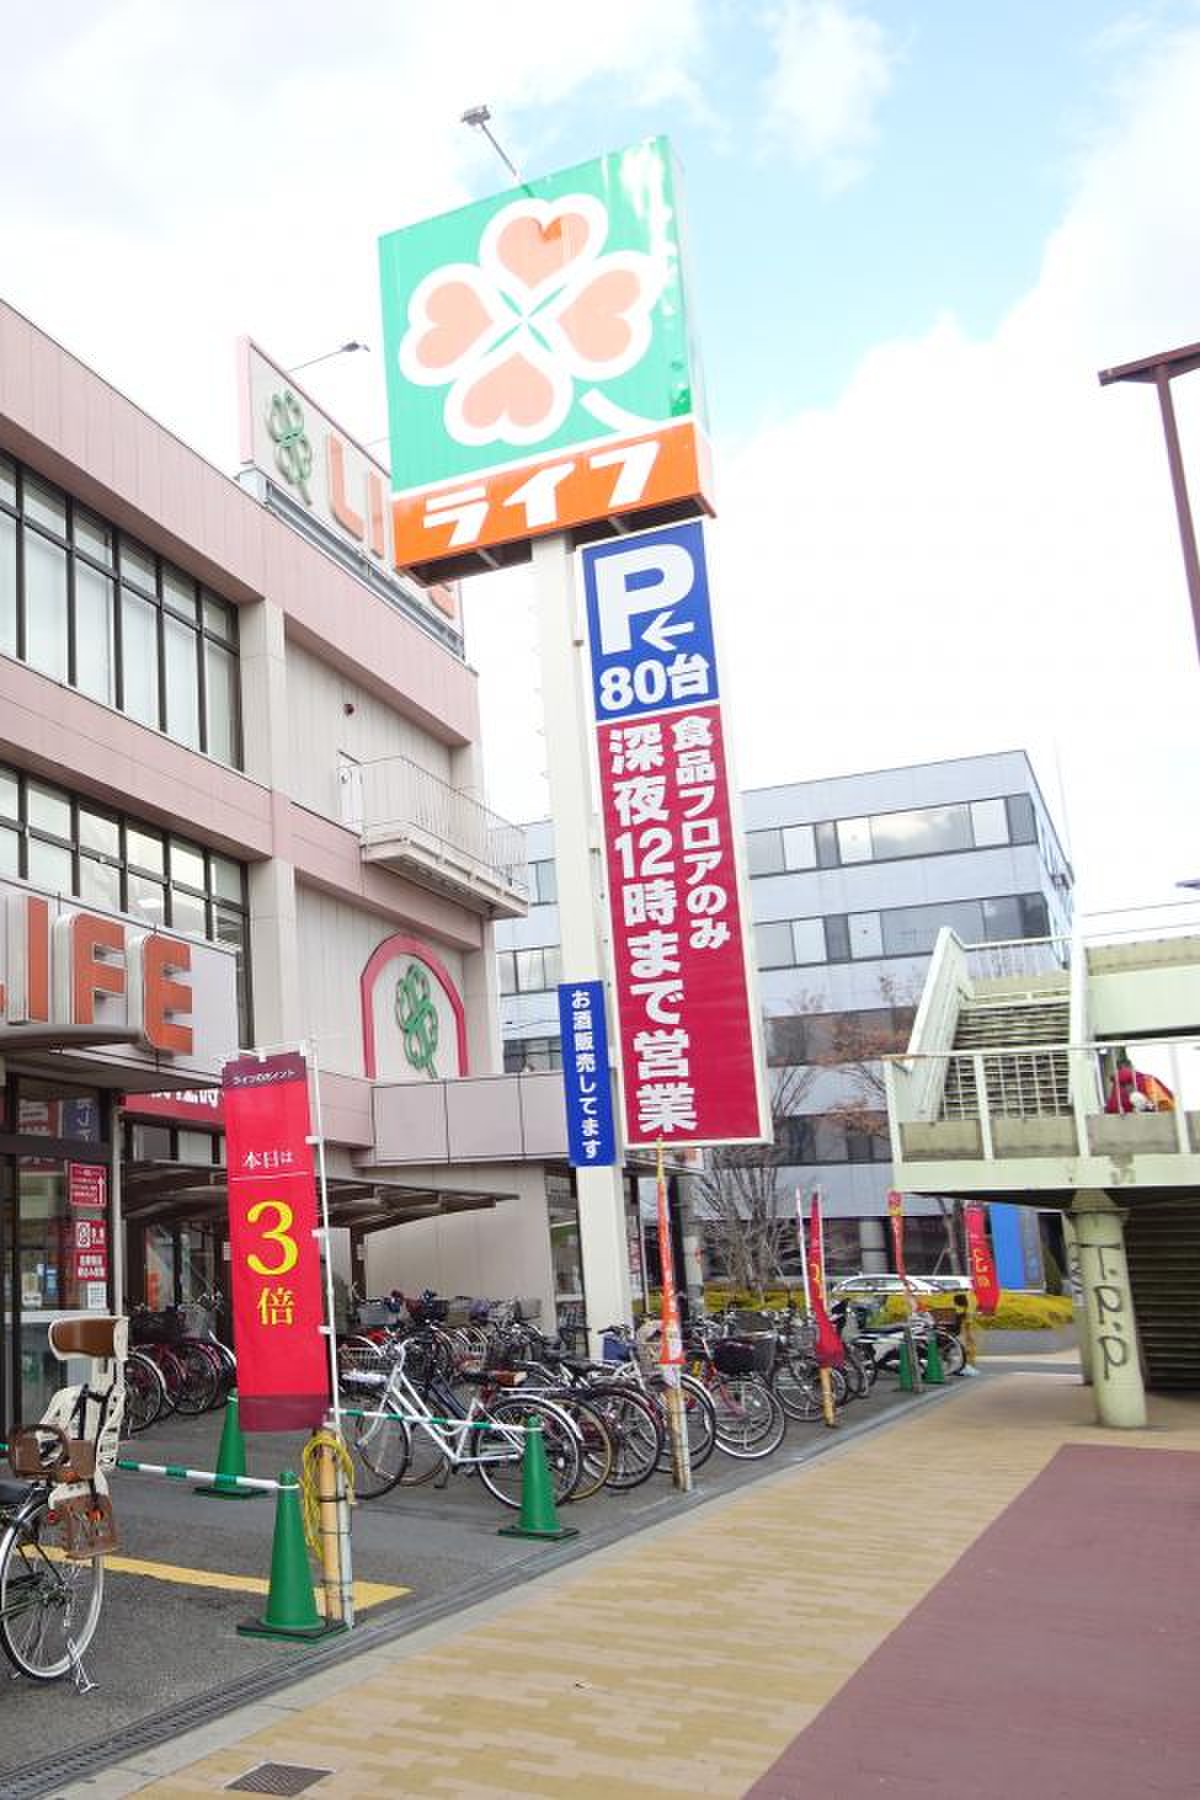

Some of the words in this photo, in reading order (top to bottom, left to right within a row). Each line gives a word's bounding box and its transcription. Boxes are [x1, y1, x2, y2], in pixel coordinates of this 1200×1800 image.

[423, 441, 660, 547] ライフ
[593, 543, 695, 656] P
[599, 653, 710, 711] 80台
[671, 715, 731, 951] 食品フロアのみ
[609, 723, 698, 1134] 深夜12時まで営業
